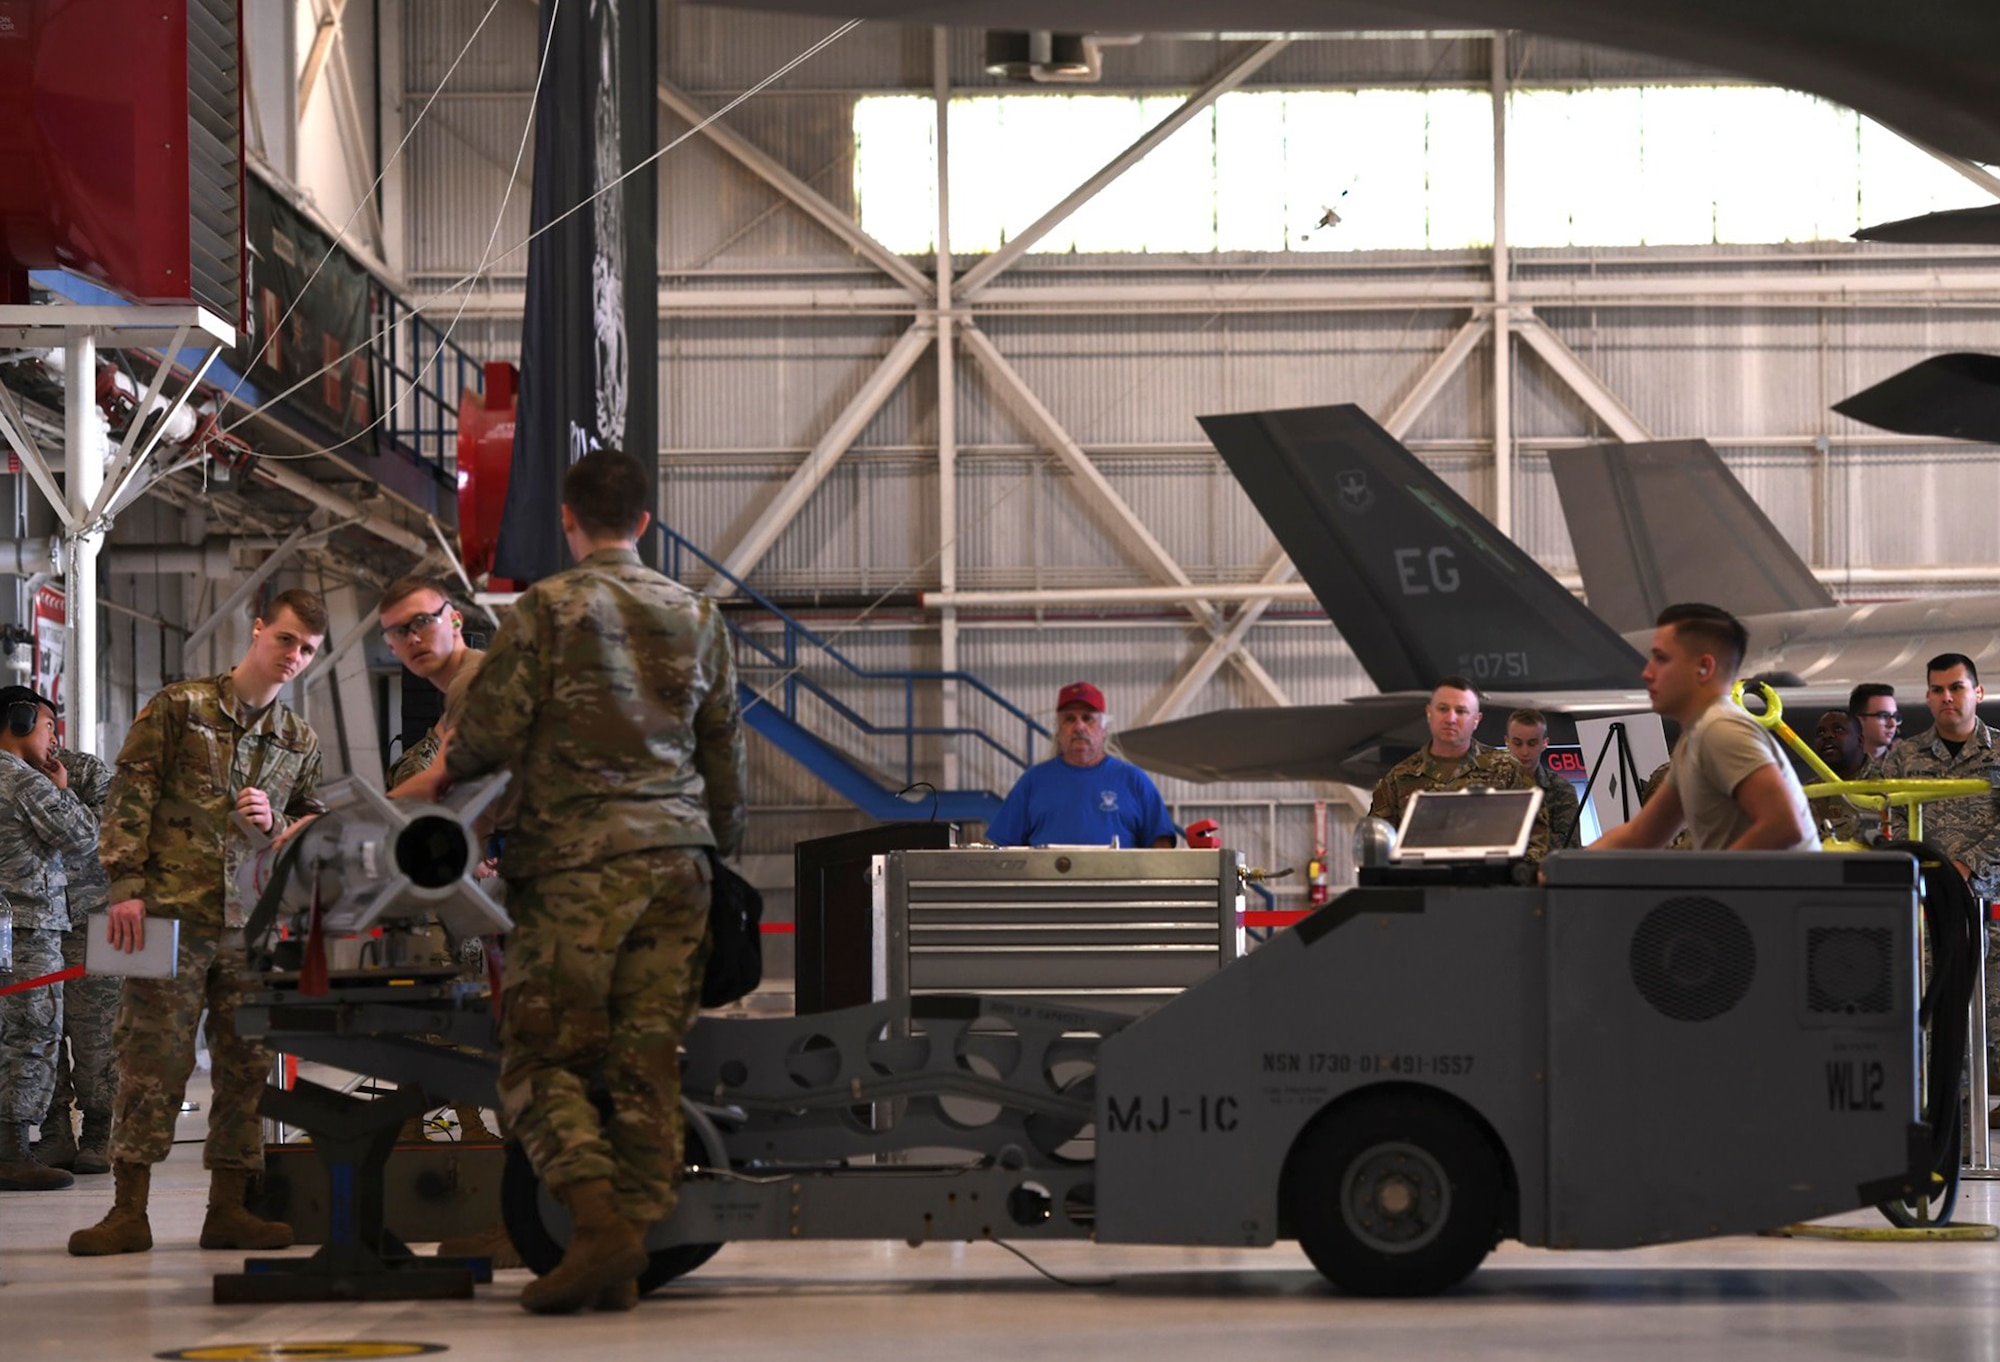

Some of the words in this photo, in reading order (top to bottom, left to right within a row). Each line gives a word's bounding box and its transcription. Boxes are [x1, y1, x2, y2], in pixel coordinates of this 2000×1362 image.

[1394, 546, 1460, 595] EG
[1473, 652, 1529, 678] 0751
[1262, 1053, 1301, 1073] NSN
[1107, 1095, 1239, 1132] MJ-1C
